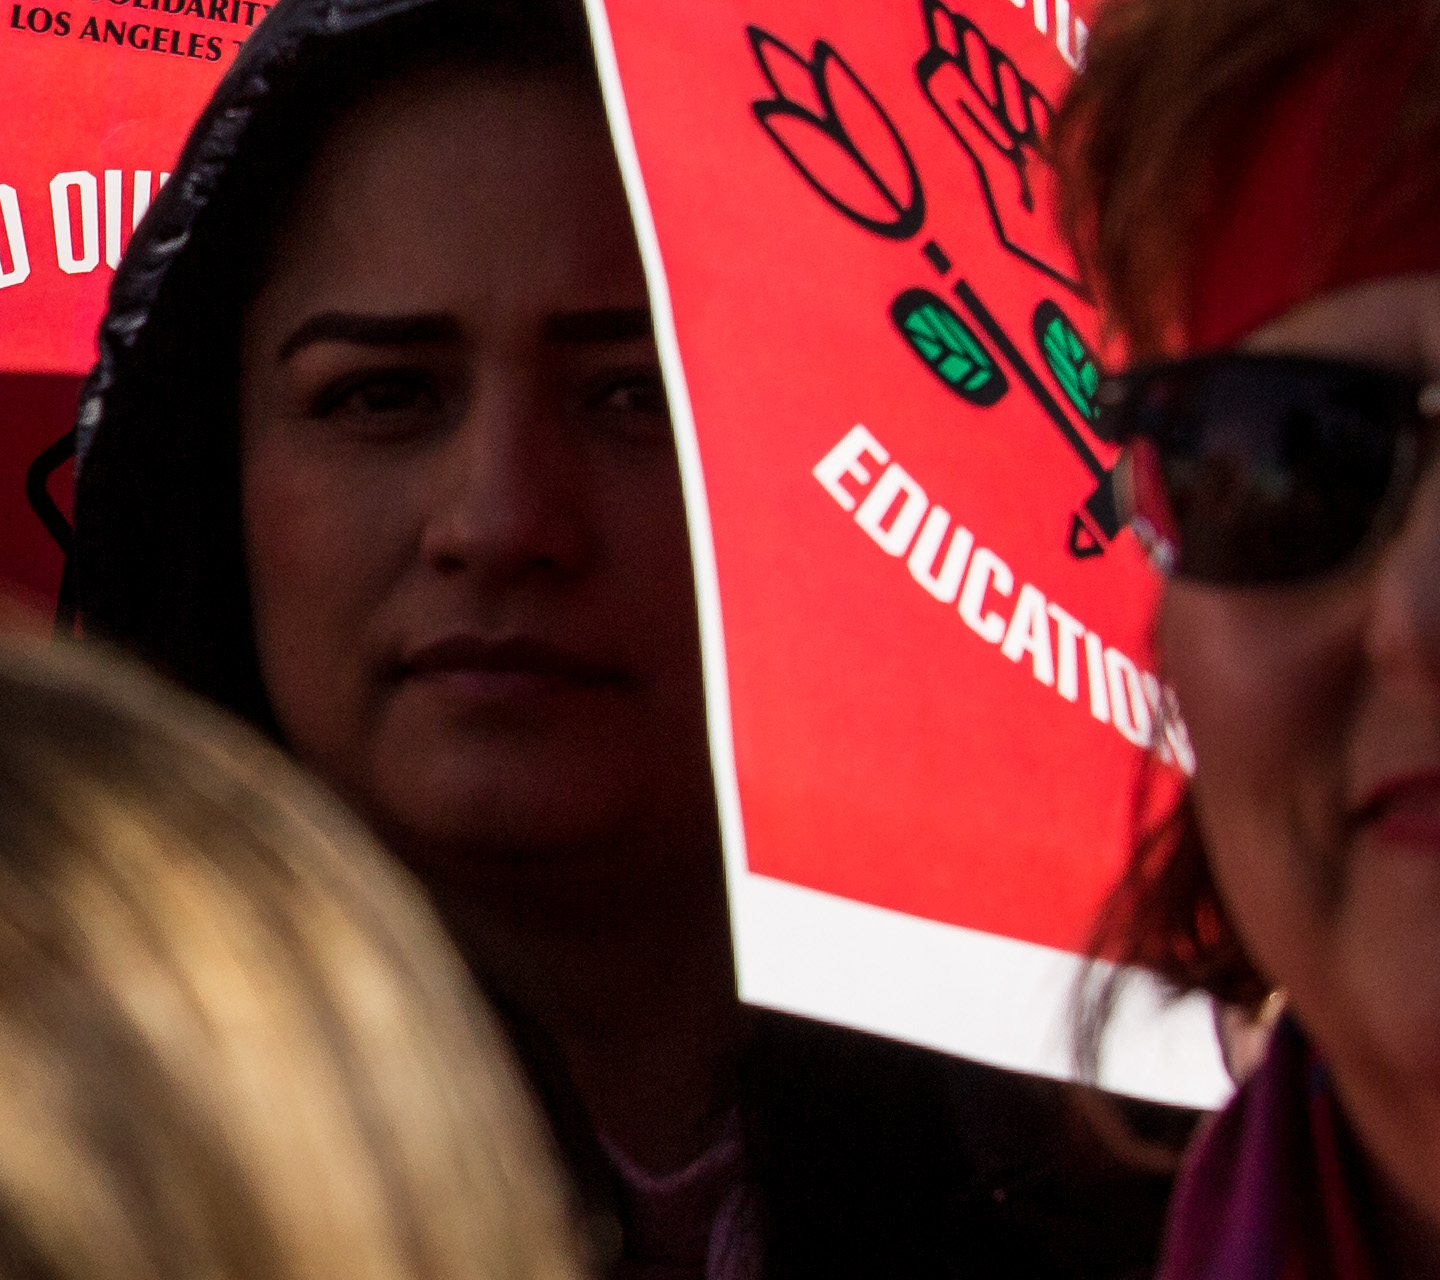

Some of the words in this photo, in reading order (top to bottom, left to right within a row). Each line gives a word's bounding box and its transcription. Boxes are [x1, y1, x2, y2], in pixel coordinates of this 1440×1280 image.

[10, 4, 71, 37] LOS
[78, 16, 223, 62] ANGELES
[49, 168, 172, 275] OU
